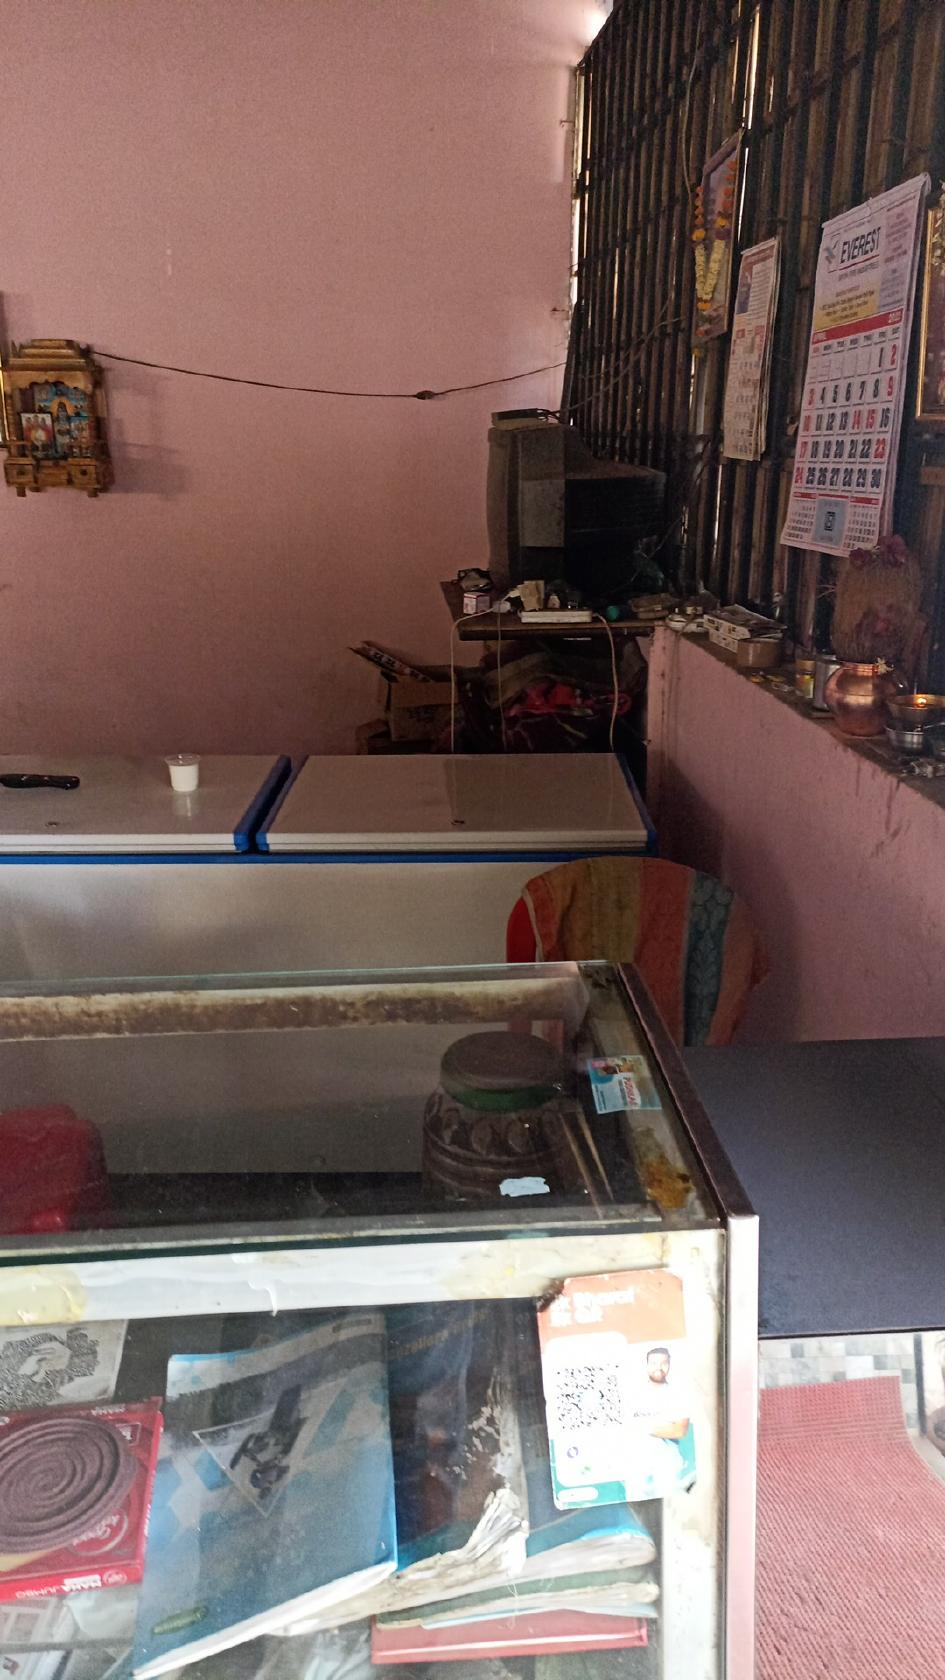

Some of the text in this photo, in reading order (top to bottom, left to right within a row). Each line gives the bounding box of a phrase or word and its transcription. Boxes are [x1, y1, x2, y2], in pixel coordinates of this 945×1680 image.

[840, 227, 881, 264] EVEREST
[878, 344, 897, 368] 1 2
[808, 376, 894, 405] 3 4 5 6 7 8 9
[803, 407, 891, 432] 10 11 12 13 14 15 16
[800, 437, 886, 459] 17 18 19 20 21 22 23
[794, 467, 882, 488] 24 25 26 27 28 29 30
[15, 1586, 60, 1599] JUMBO
